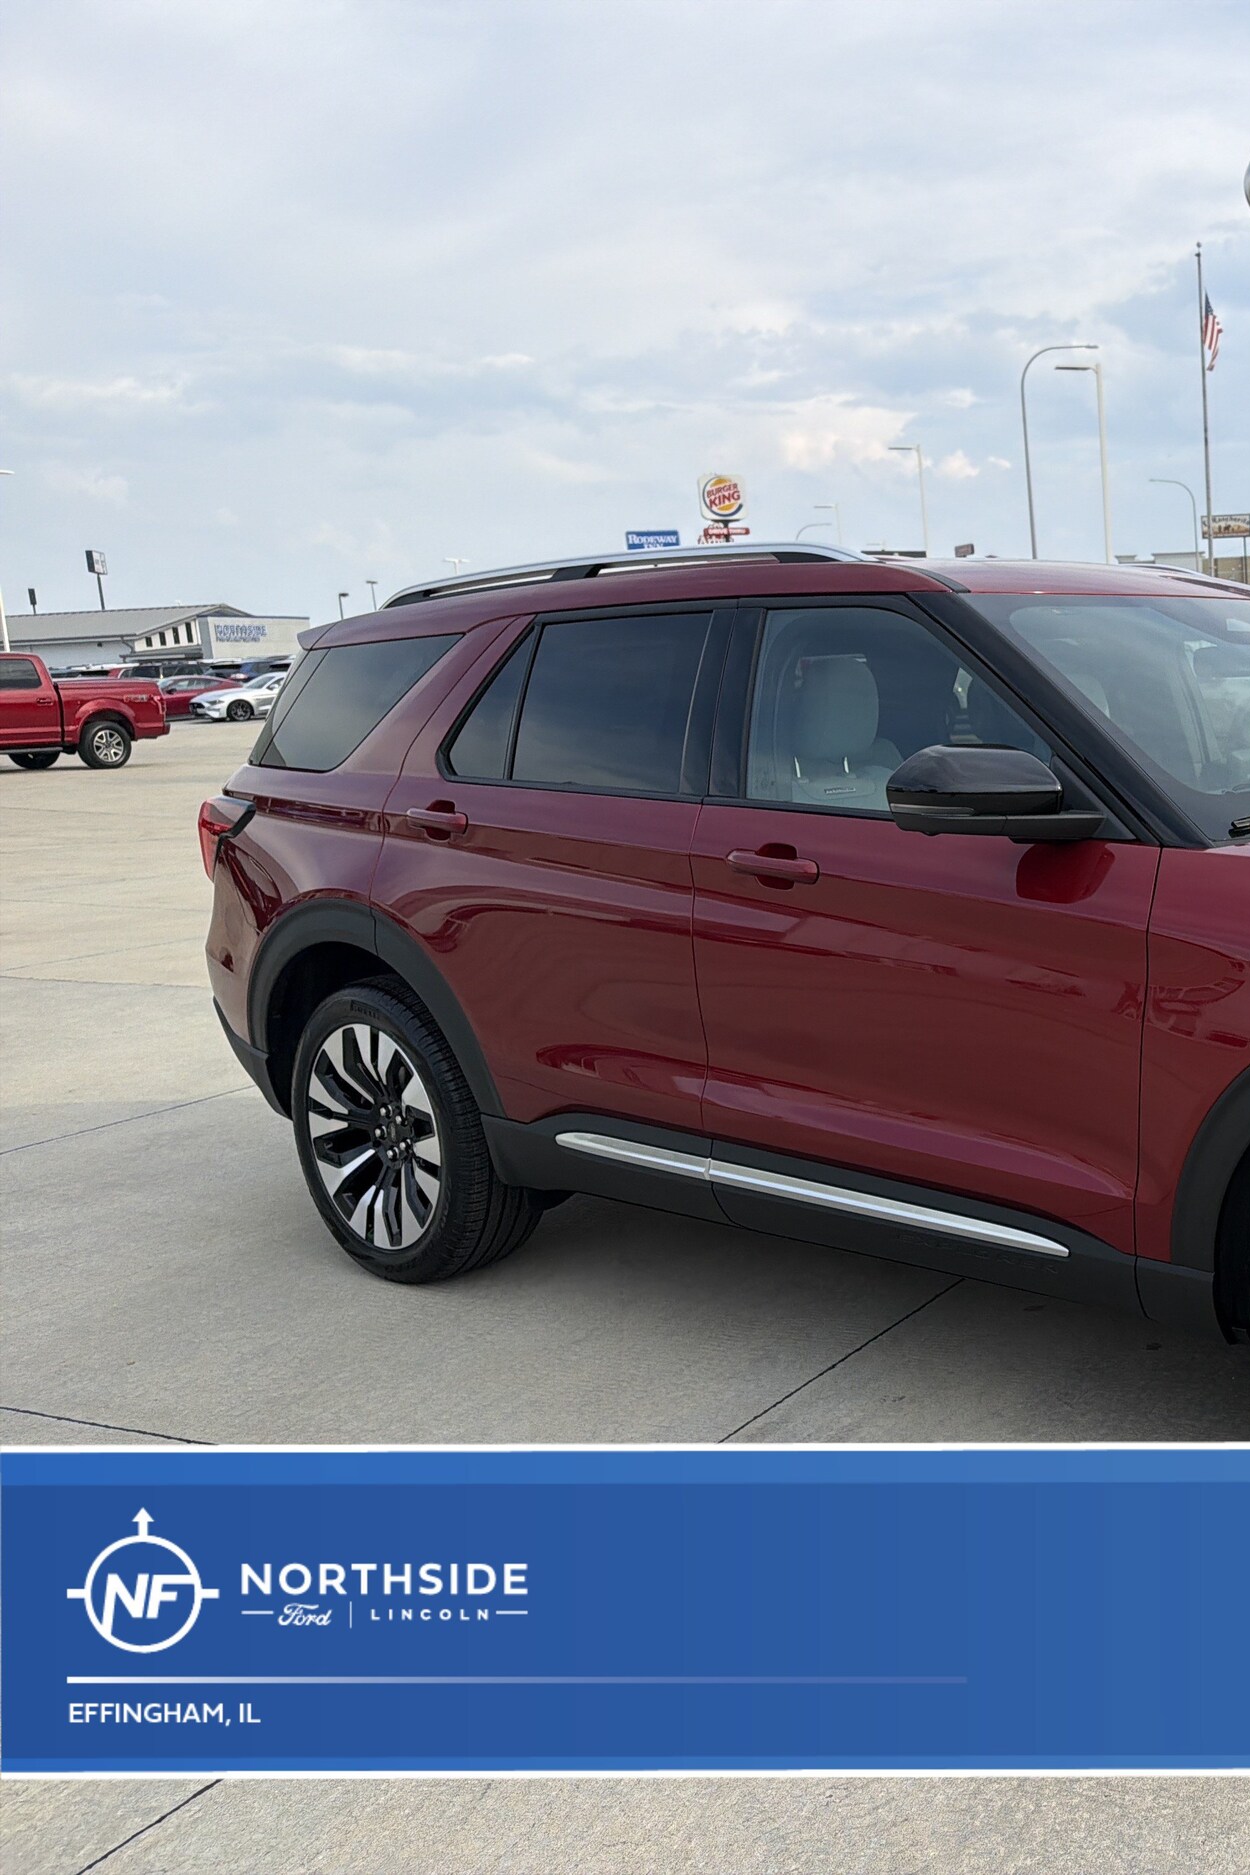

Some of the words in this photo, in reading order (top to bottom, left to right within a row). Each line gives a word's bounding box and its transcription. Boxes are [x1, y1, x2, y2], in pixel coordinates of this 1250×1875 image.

[707, 483, 738, 498] BURGER
[709, 491, 740, 508] KING
[628, 534, 677, 544] RODEWAY
